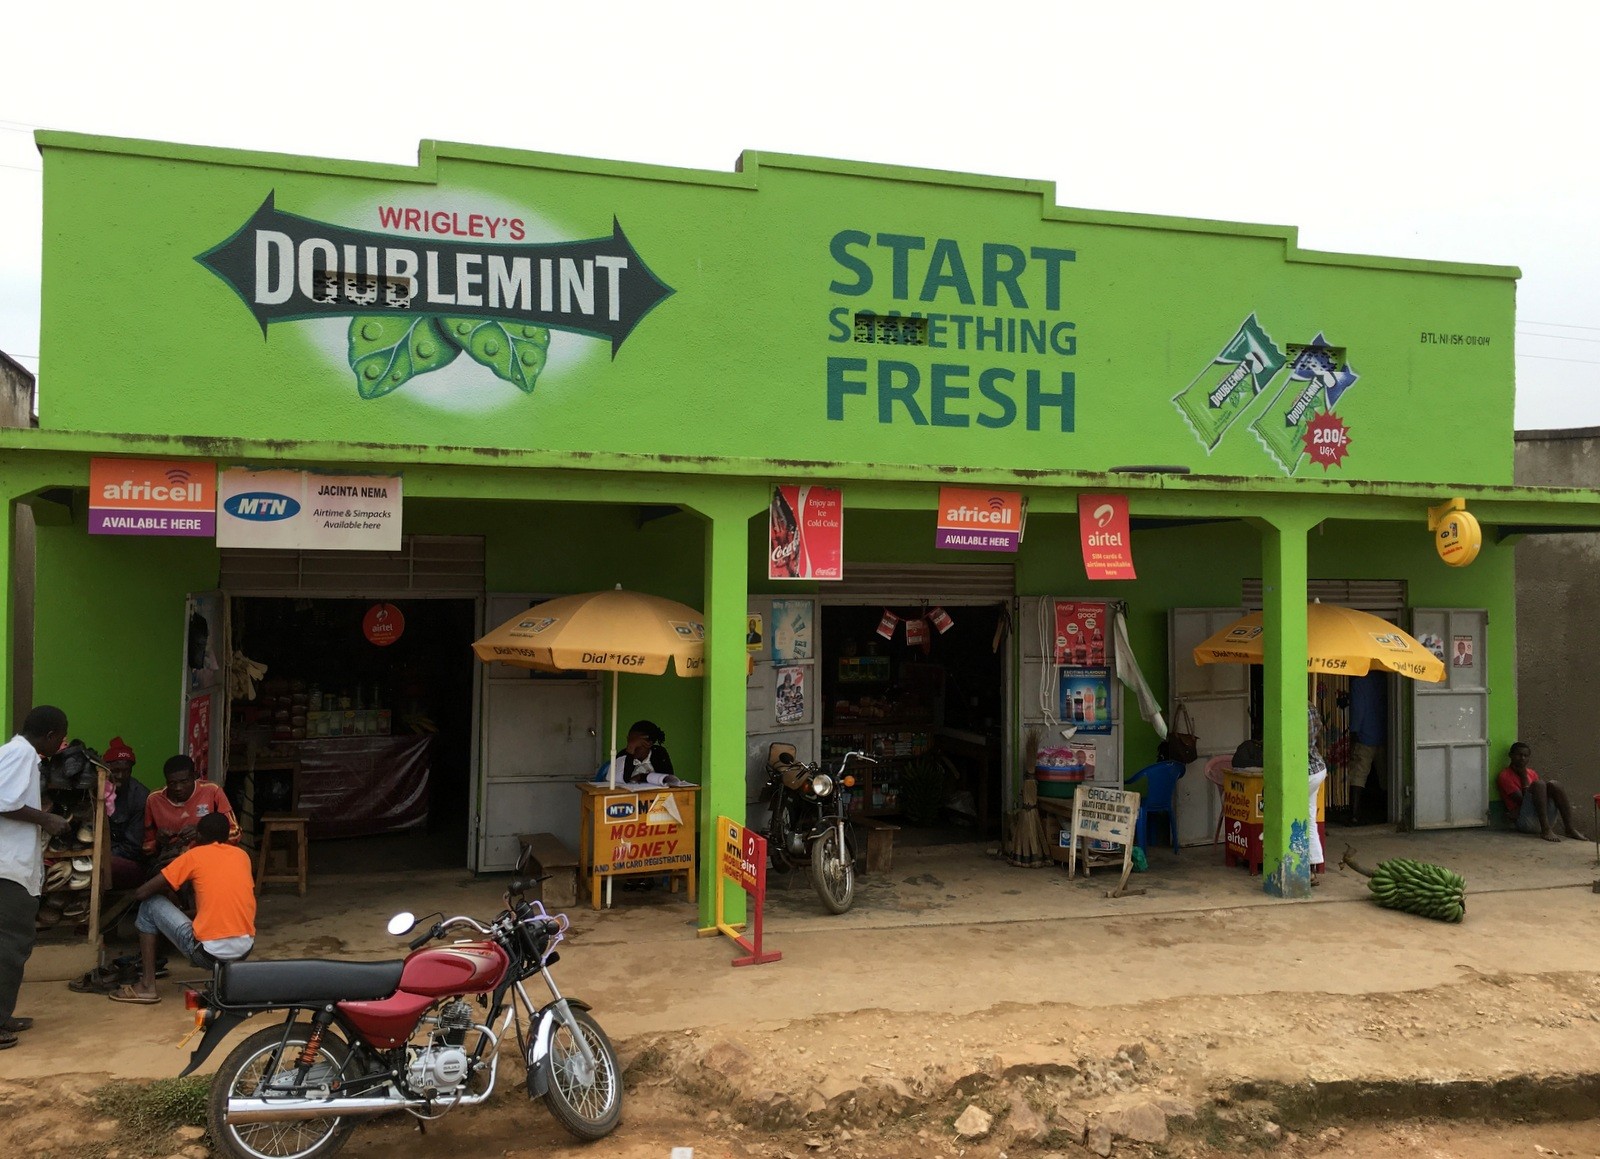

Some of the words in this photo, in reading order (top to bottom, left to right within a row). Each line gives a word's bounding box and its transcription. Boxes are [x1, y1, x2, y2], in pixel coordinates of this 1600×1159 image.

[378, 205, 526, 241] WRIGLEY'S
[254, 229, 628, 321] DOUBLEMINT
[829, 229, 1077, 311] START
[1210, 360, 1250, 407] DOUBLEMINT
[826, 356, 1076, 433] FRESH
[1287, 376, 1324, 425] DOUBLEMINT
[1319, 446, 1337, 460] UGX
[103, 479, 202, 502] africell
[318, 485, 358, 498] JACINTA
[360, 487, 388, 499] NEMA
[237, 498, 287, 515] MTN
[809, 499, 826, 508] Enjoy
[102, 516, 168, 529] AVAILABLE
[171, 517, 201, 530] HERE
[313, 509, 343, 518] Airtime
[344, 510, 351, 518] &
[352, 509, 391, 520] Simpacks
[947, 506, 1011, 525] africell
[323, 520, 362, 530] Available
[363, 521, 382, 530] here
[945, 535, 988, 546] AVAILABLE
[989, 537, 1009, 547] HERE
[1088, 532, 1122, 547] airtel
[372, 623, 393, 632] airtel
[581, 652, 607, 664] Dial
[1230, 780, 1245, 792] MTN
[1224, 792, 1250, 808] Mobile
[610, 805, 634, 816] MTN
[1225, 804, 1251, 821] Money
[610, 822, 678, 840] MOBILE
[1227, 833, 1248, 848] airtel
[612, 840, 679, 862] MONEY
[727, 842, 742, 859] MTN
[594, 864, 610, 874] AND
[644, 854, 692, 866] REGISTRATION
[741, 859, 757, 877] airt
